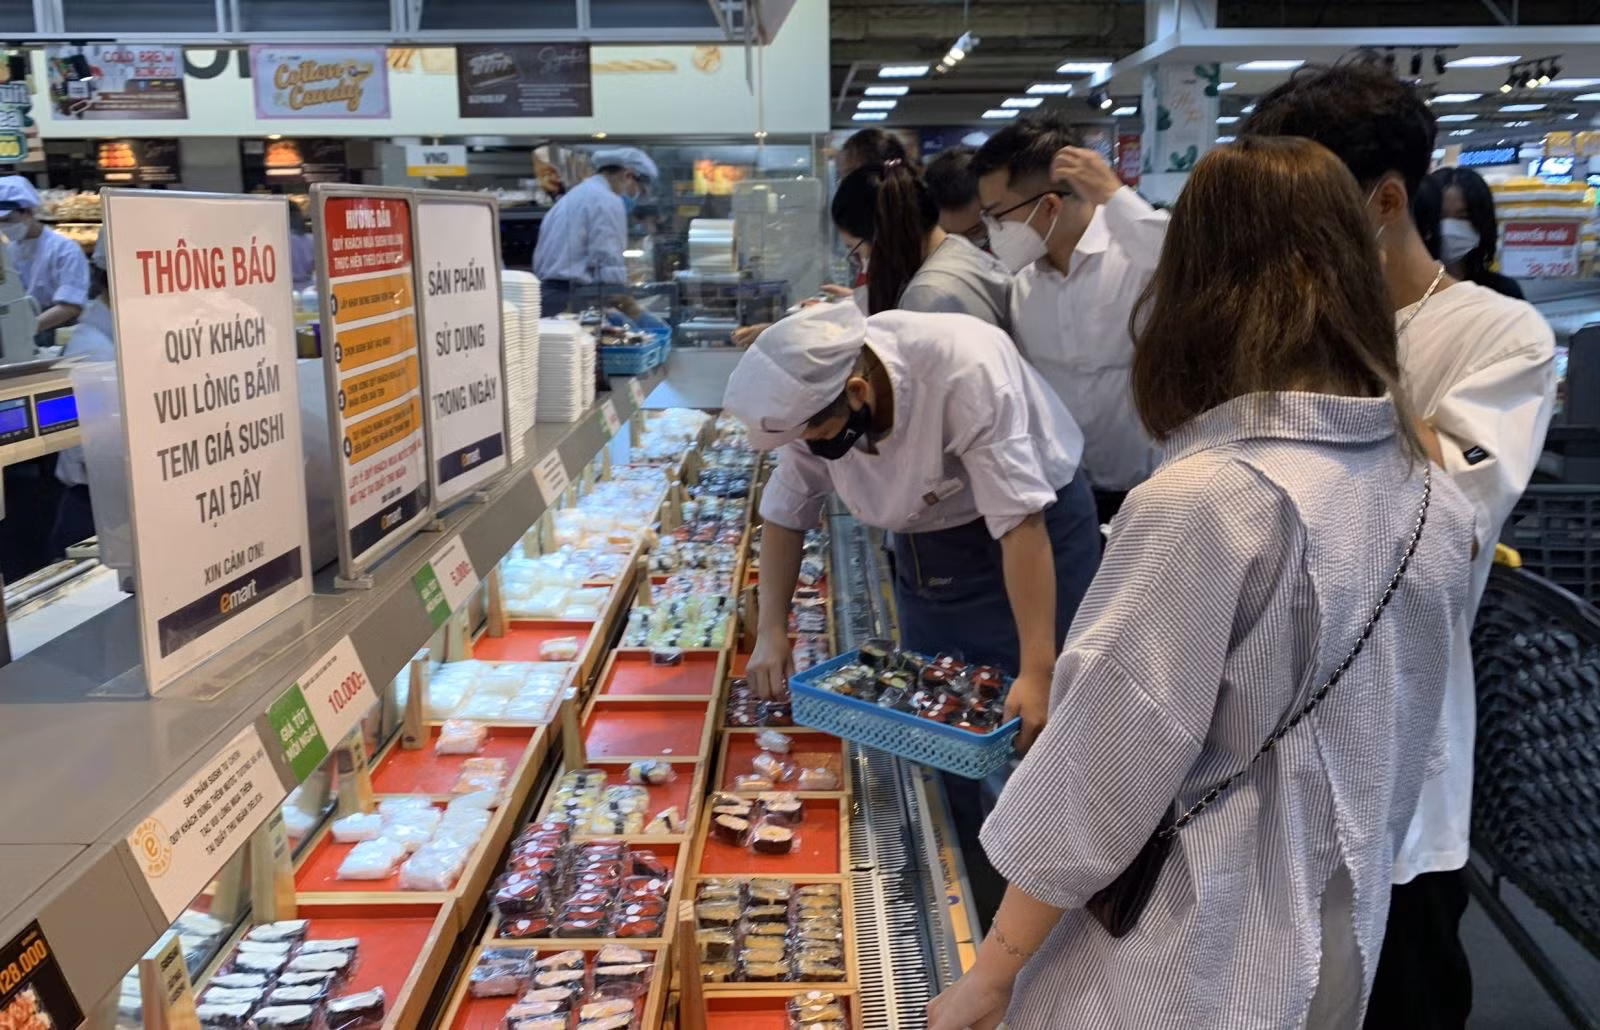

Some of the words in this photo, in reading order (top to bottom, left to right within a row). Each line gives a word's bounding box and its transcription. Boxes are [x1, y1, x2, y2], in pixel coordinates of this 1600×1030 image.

[140, 51, 175, 63] BREW
[274, 60, 344, 90] Cotton
[289, 78, 363, 112] Candy
[136, 239, 226, 295] THÔNG
[232, 236, 276, 286] BÁO
[428, 262, 451, 297] SẢN
[454, 258, 486, 294] PHẨM
[165, 319, 203, 364] QUÝ
[209, 313, 266, 354] KHÁCH
[435, 321, 451, 357] SỬ
[455, 324, 485, 358] DỤNG
[153, 386, 188, 424] VUI
[193, 373, 240, 414] LÒNG
[244, 357, 280, 401] BẤM
[432, 386, 466, 421] TRONG
[469, 374, 497, 408] NGÀY
[157, 439, 200, 482] TEM
[205, 422, 235, 466] GIÁ
[239, 413, 285, 454] SUSHI
[196, 485, 226, 528] TẠI
[230, 468, 261, 510] ĐÂY
[204, 562, 221, 587] XIN
[220, 578, 257, 613] emart
[280, 719, 296, 742] GIÁ
[292, 707, 308, 729] TỐT
[207, 767, 222, 785] SUSHI
[181, 813, 199, 834] KHÁCH
